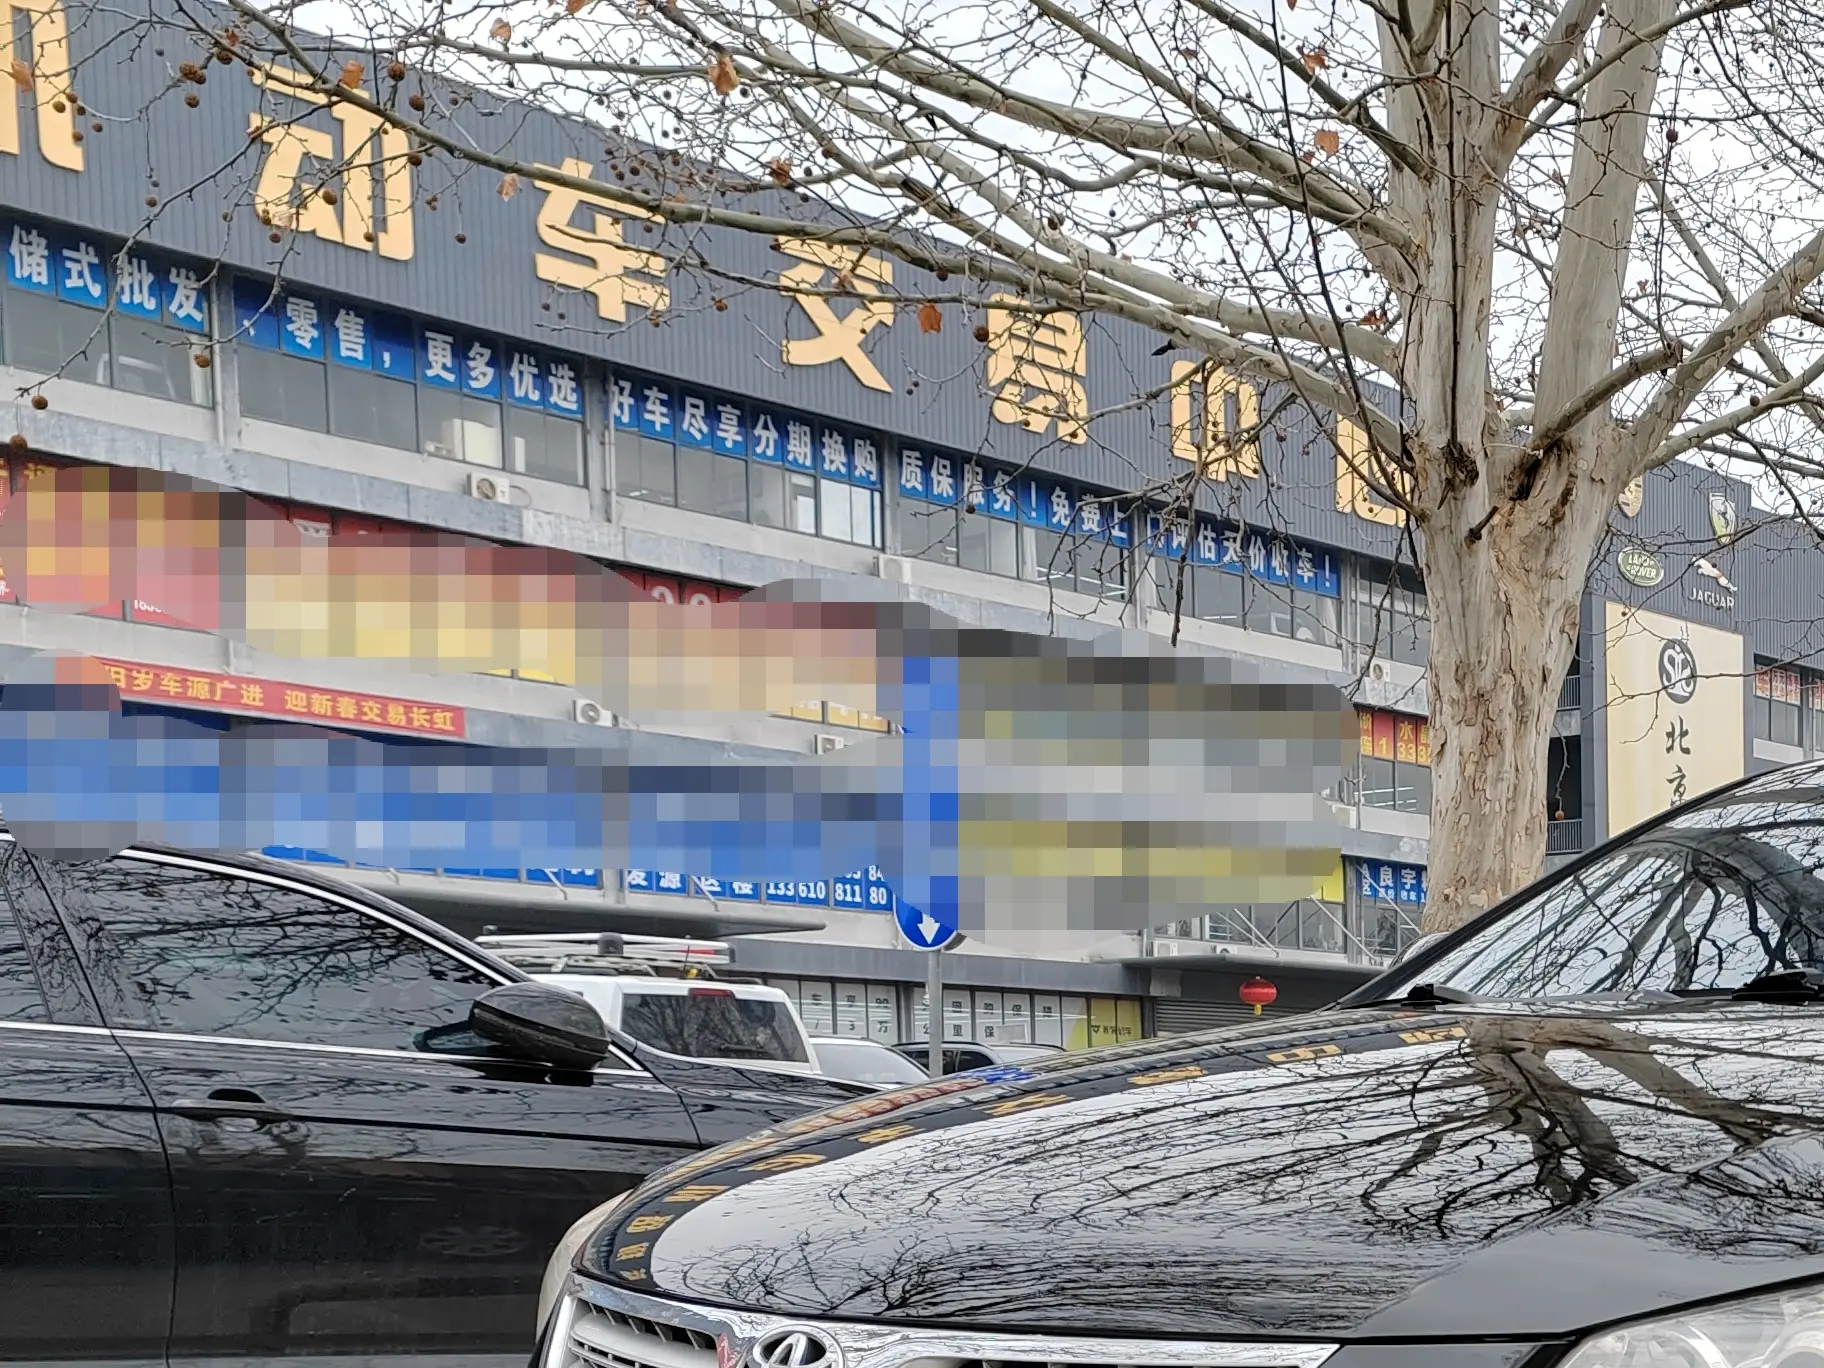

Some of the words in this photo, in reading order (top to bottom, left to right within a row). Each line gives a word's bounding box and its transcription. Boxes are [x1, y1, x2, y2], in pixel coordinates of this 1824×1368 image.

[1689, 587, 1735, 611] JAGUAR
[284, 689, 456, 732] 迎新春交易长虹
